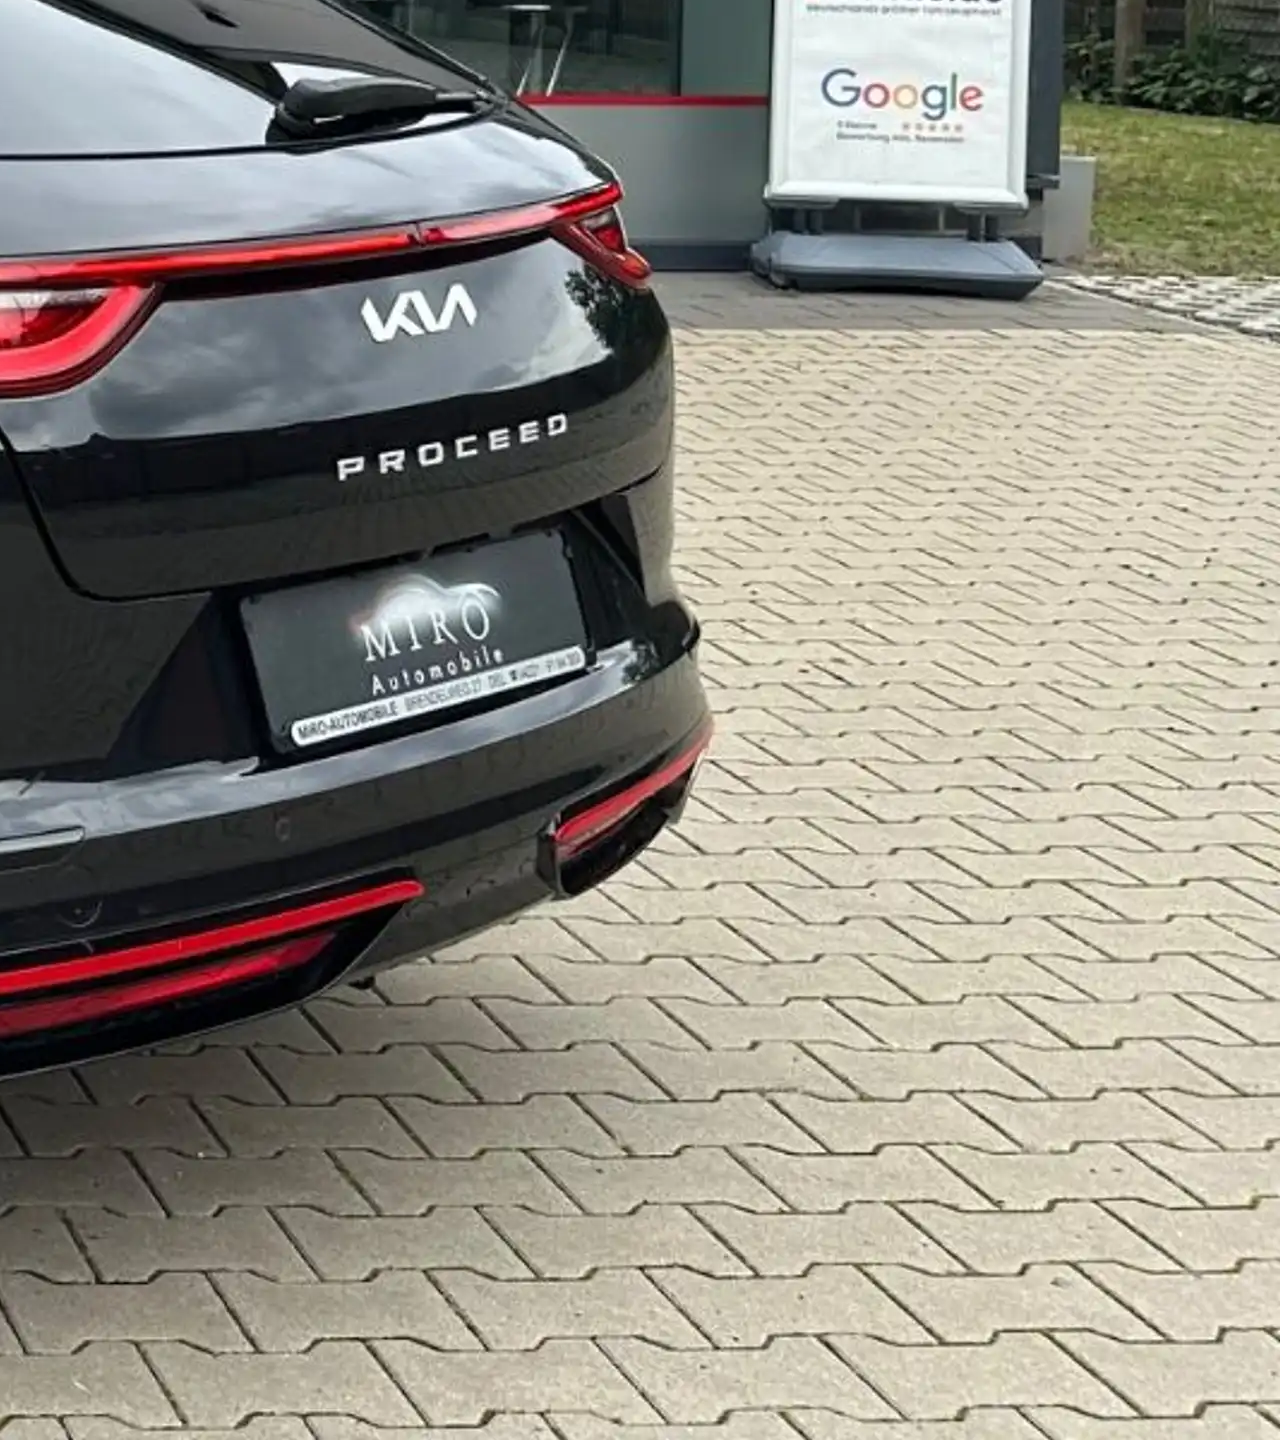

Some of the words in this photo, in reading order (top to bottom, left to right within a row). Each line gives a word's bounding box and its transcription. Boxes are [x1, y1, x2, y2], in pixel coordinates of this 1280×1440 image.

[821, 67, 984, 121] Google
[361, 283, 478, 342] KIA
[336, 412, 569, 482] PROCEED
[361, 598, 490, 662] MIRO
[371, 644, 504, 696] Automobile
